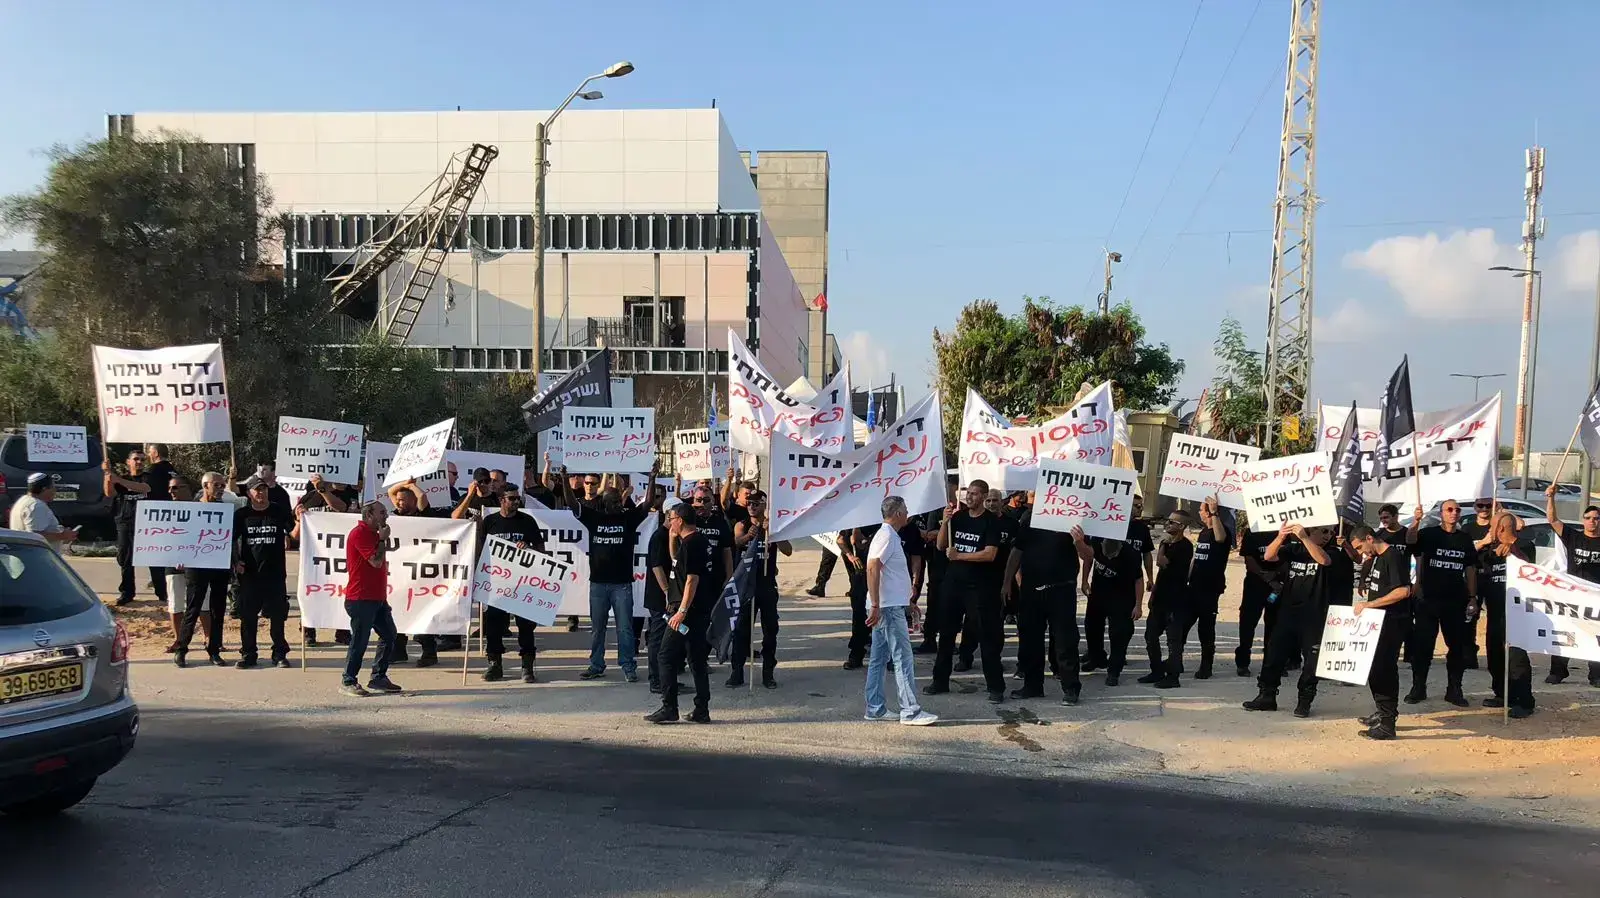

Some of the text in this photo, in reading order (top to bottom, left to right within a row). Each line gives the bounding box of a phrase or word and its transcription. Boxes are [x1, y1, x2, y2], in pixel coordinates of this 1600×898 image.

[107, 362, 210, 377] דדי שימחי
[105, 382, 225, 399] חוסך בכסף
[106, 405, 137, 417] אדם
[570, 415, 645, 429] דדי שימחי
[29, 430, 84, 440] דדי שימחי
[312, 427, 337, 444] נלחם
[338, 434, 359, 446] אני
[565, 433, 615, 441] גיבוי
[677, 431, 710, 445] שימחי
[966, 430, 1016, 448] הבא
[1031, 419, 1108, 458] האסון
[284, 447, 350, 458] ודדי שימחי
[874, 434, 927, 480] נותן
[1177, 441, 1250, 464] דדי שימחי
[291, 463, 339, 474] נלחם בי
[1242, 462, 1326, 485] אני נלחם באש
[1042, 469, 1132, 496] דדי שימחי
[1201, 481, 1243, 496] מפקדים
[1044, 485, 1122, 511] אל תשרוף
[1251, 485, 1320, 507] ודדי שימחי
[144, 508, 224, 524] דדי שימחי
[1263, 506, 1314, 524] נלחם בי
[137, 527, 230, 544] נותן גיבוי
[247, 525, 277, 534] הכבאים
[597, 525, 624, 533] הכבאים
[955, 531, 980, 542] הכבאים
[177, 542, 229, 559] למפקדים
[318, 533, 459, 555] דדי שחי
[489, 539, 535, 569] שימחי
[1436, 548, 1465, 558] הכבאים
[402, 562, 468, 580] חוסך
[541, 557, 567, 581] דדי
[480, 562, 561, 594] האסון הבא
[496, 587, 518, 600] השם
[535, 599, 556, 609] יהיה
[1360, 621, 1379, 637] אני
[1325, 641, 1368, 652] ודדי שימחי
[1325, 659, 1356, 672] נלחם בי
